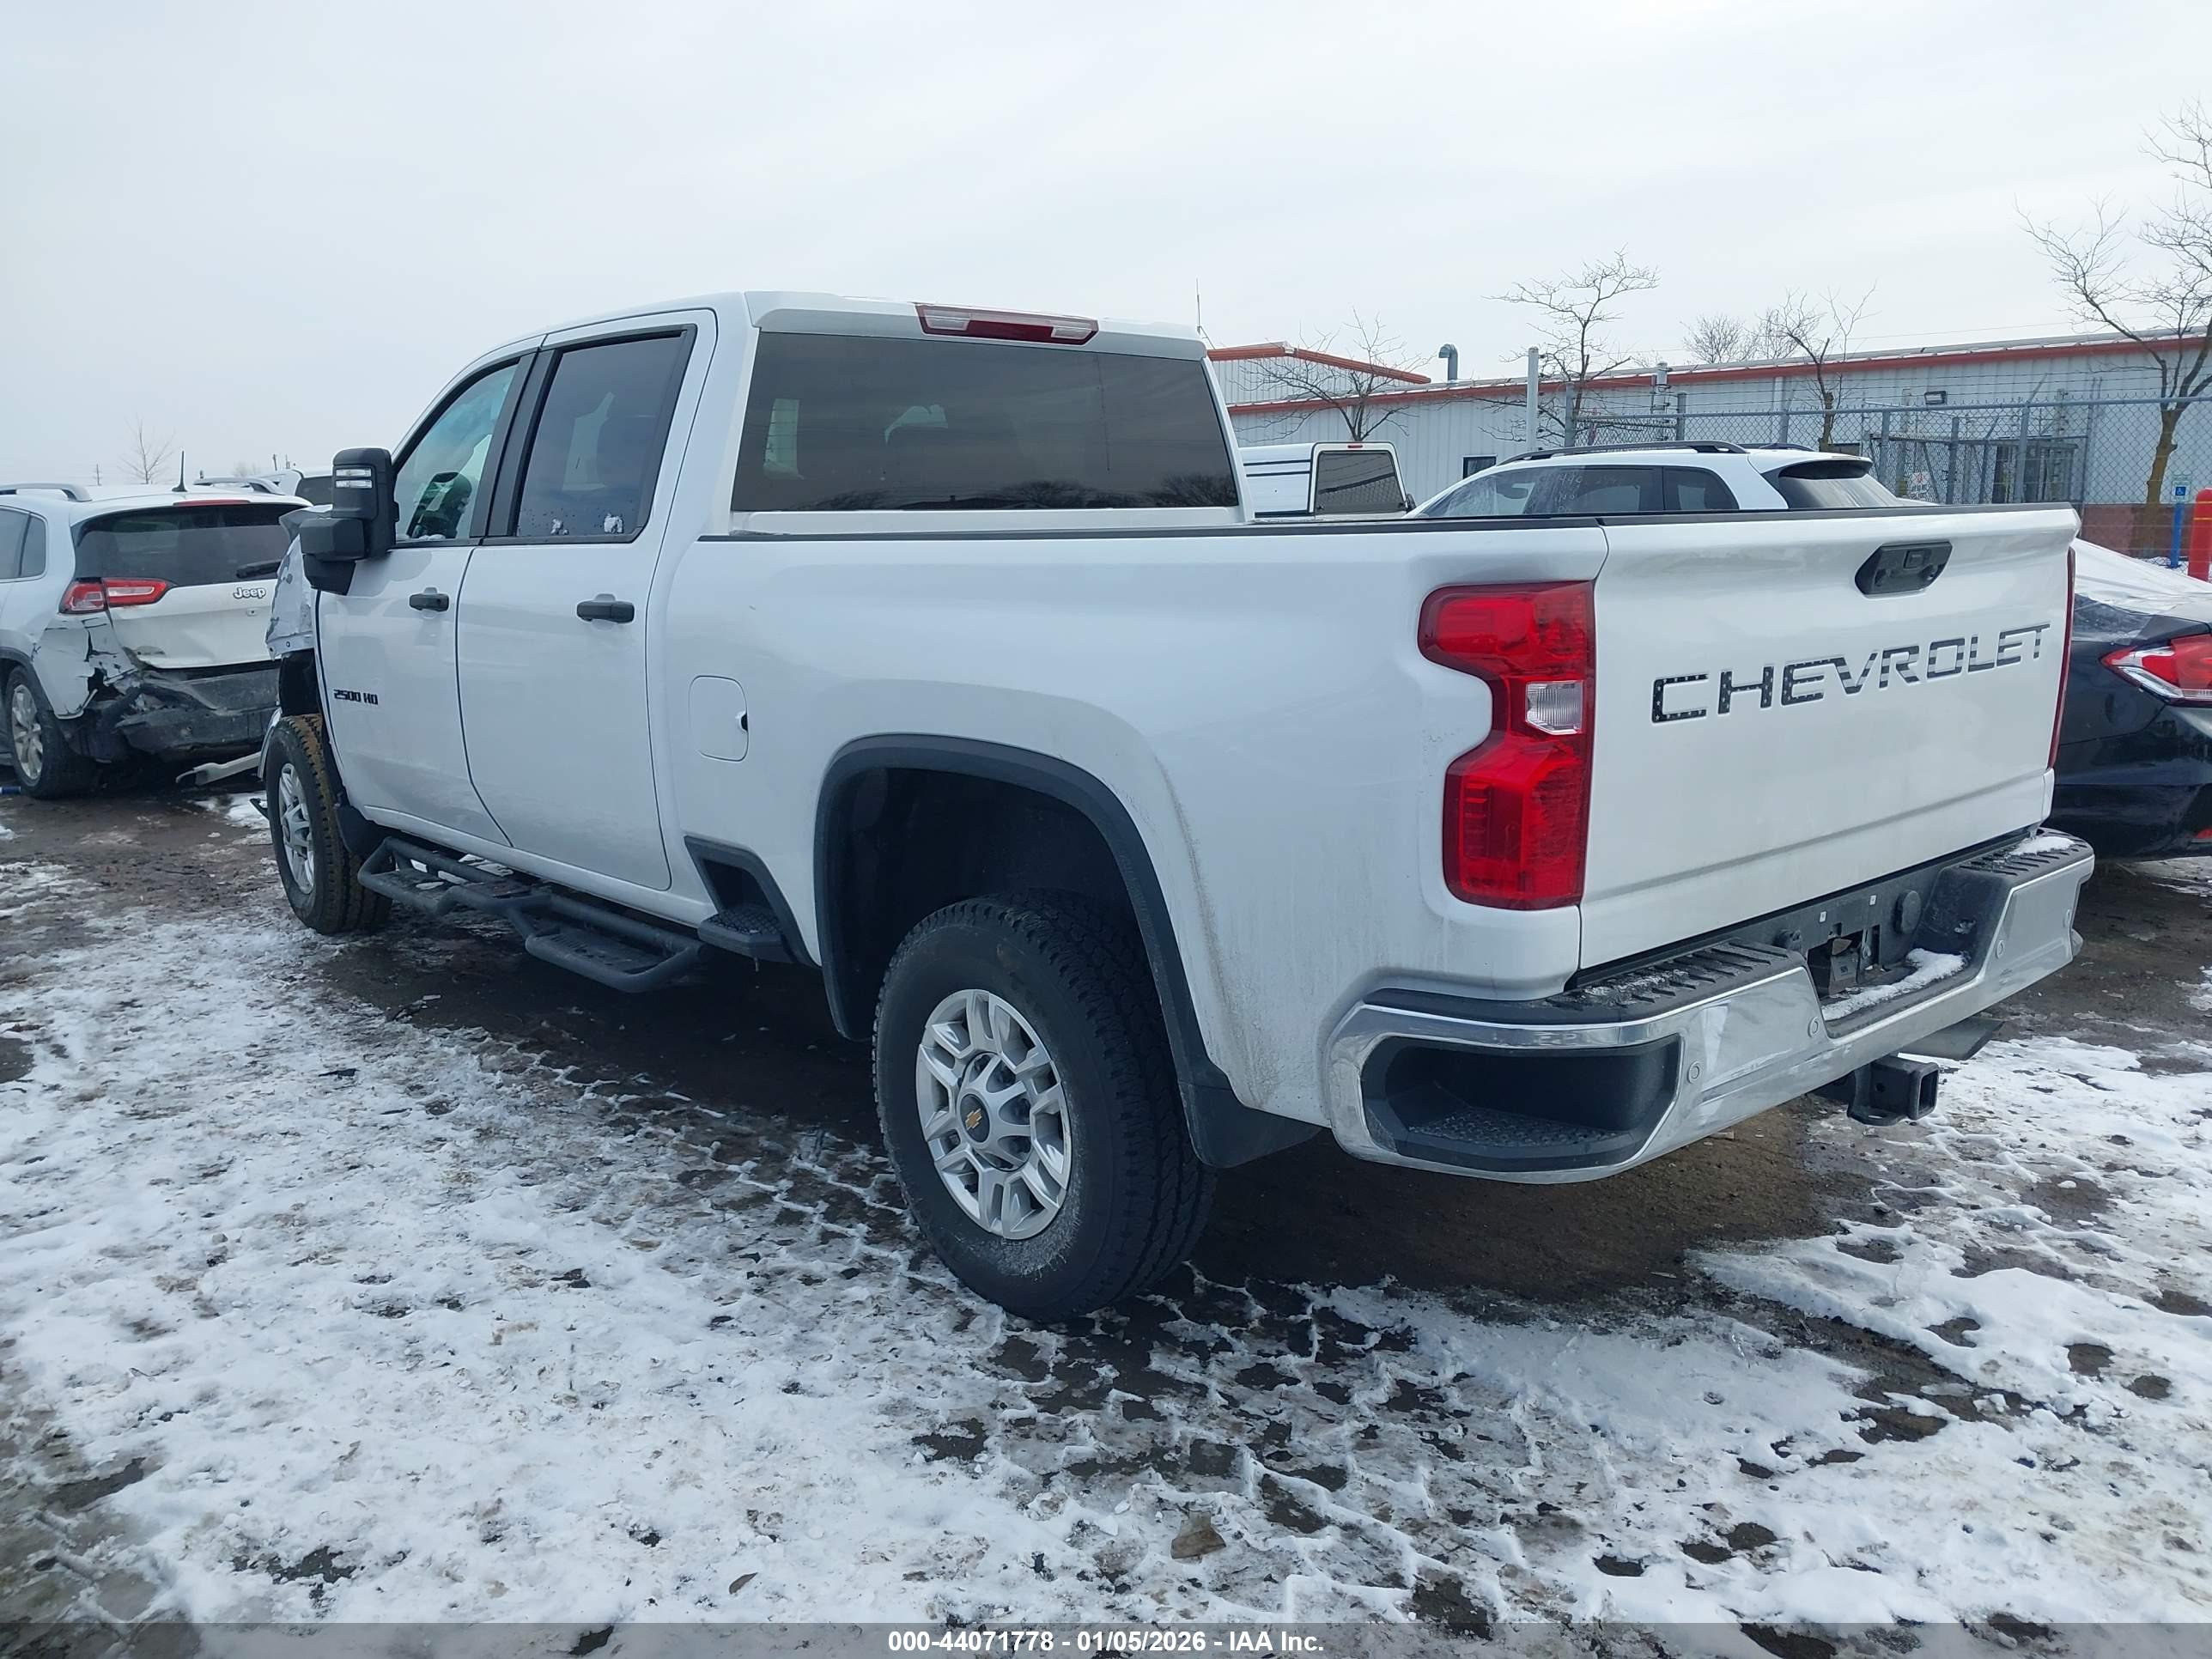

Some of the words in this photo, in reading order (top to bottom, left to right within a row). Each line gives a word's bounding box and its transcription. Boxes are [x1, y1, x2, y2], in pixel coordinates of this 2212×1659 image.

[233, 586, 267, 599] Jeep
[1650, 621, 2051, 725] CHEVROLET
[333, 689, 362, 702] 2500
[363, 692, 379, 705] HD
